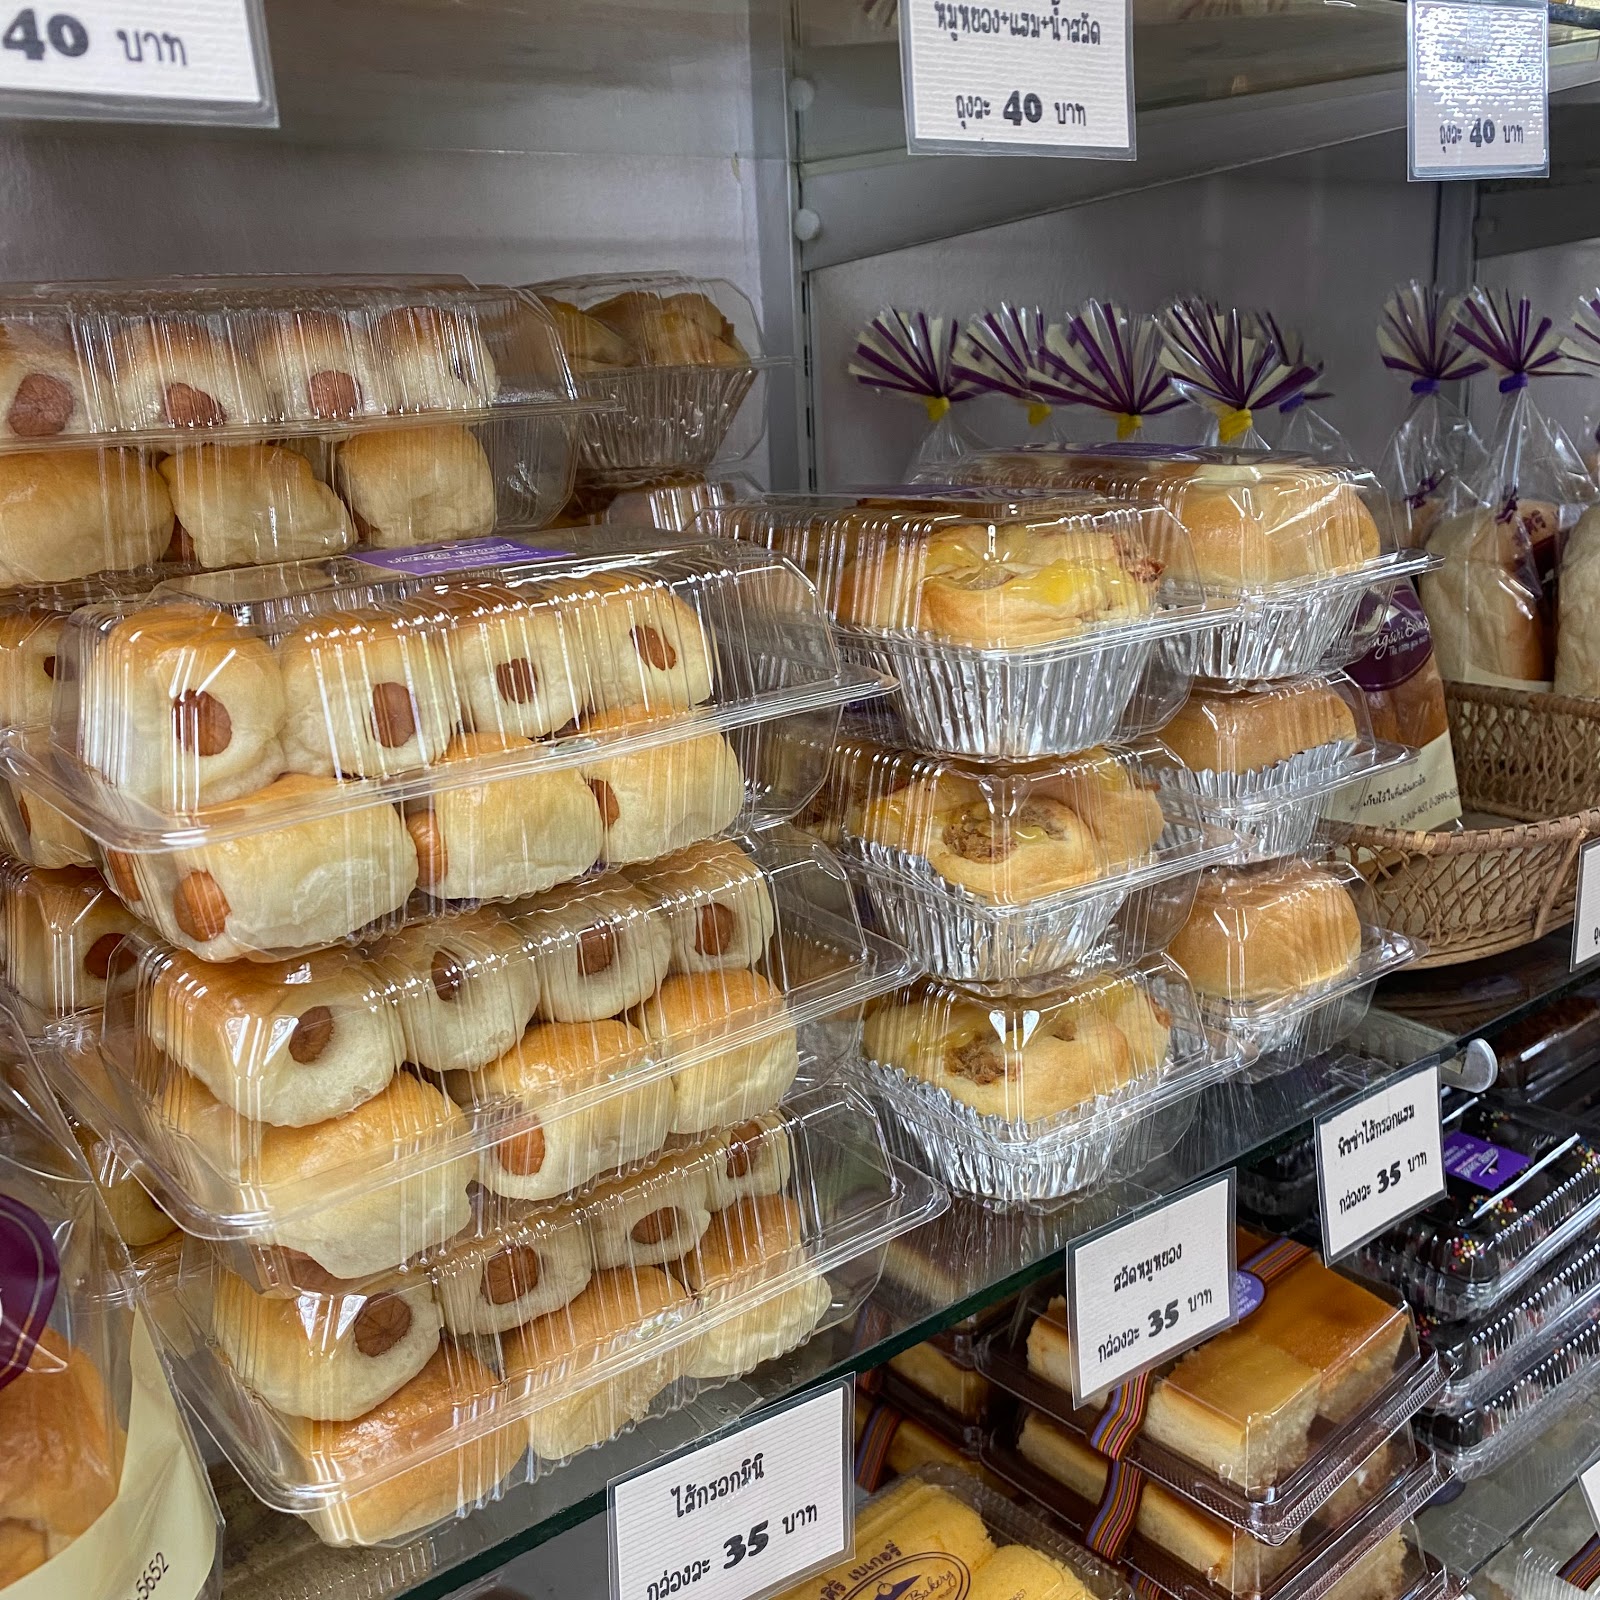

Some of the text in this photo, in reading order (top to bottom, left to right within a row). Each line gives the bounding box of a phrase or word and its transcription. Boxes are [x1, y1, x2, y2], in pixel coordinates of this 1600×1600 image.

[2, 8, 187, 66] 40 บาท
[955, 90, 1086, 129] ถุงละ 40 บาท
[1439, 118, 1524, 153] ถุงละ 40 บาท
[1339, 1185, 1371, 1215] กล่องละ
[1376, 1160, 1401, 1194] 35
[1407, 1151, 1427, 1173] บาท
[1113, 1243, 1182, 1292] สลัดหมูหยอง
[1098, 1327, 1140, 1362] กล่องละ
[1147, 1299, 1179, 1338] 35
[1187, 1288, 1213, 1313] บาท
[670, 1452, 764, 1518] ไส้กรอกมินิ
[646, 1504, 818, 1600] กล่องละ 35 บาท
[820, 1540, 902, 1600] ศิริ เบเกอรี่
[904, 1570, 957, 1600] Bakery
